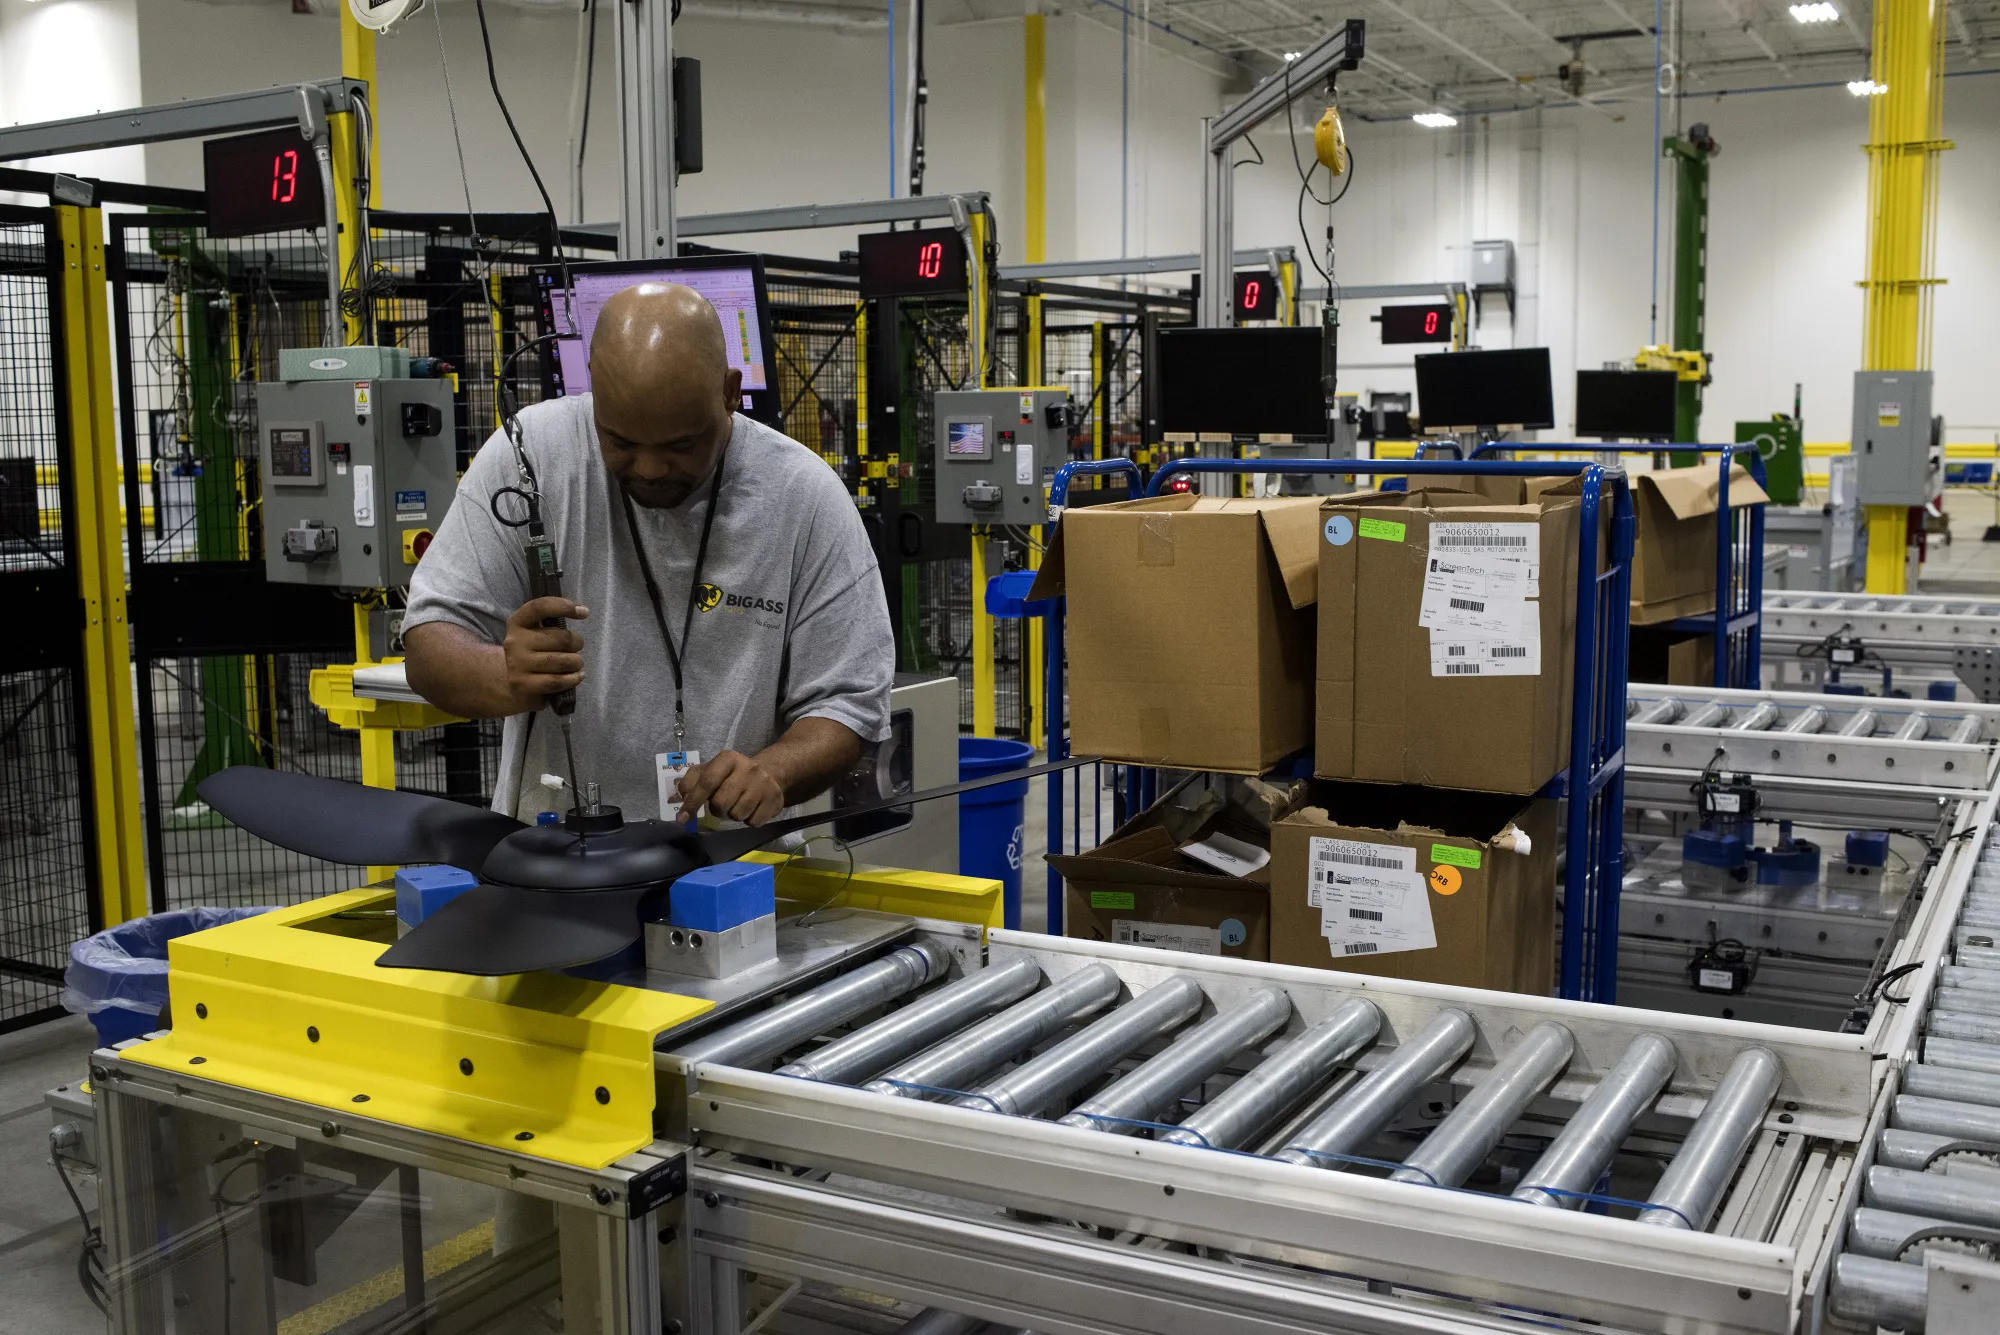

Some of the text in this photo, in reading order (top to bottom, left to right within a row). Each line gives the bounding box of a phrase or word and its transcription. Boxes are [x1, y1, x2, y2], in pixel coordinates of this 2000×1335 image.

[272, 149, 297, 203] 13
[919, 242, 942, 278] 10
[1244, 281, 1260, 309] 0
[1424, 311, 1438, 335] 0
[1327, 525, 1338, 535] BL
[1445, 528, 1500, 536] 9060650012
[1440, 561, 1485, 575] ScreenTech
[1325, 844, 1378, 857] 9060650012
[1342, 841, 1371, 849] SOLUTION
[1336, 873, 1380, 886] ScreenTech
[1430, 870, 1449, 886] ORB
[1229, 934, 1239, 942] BL
